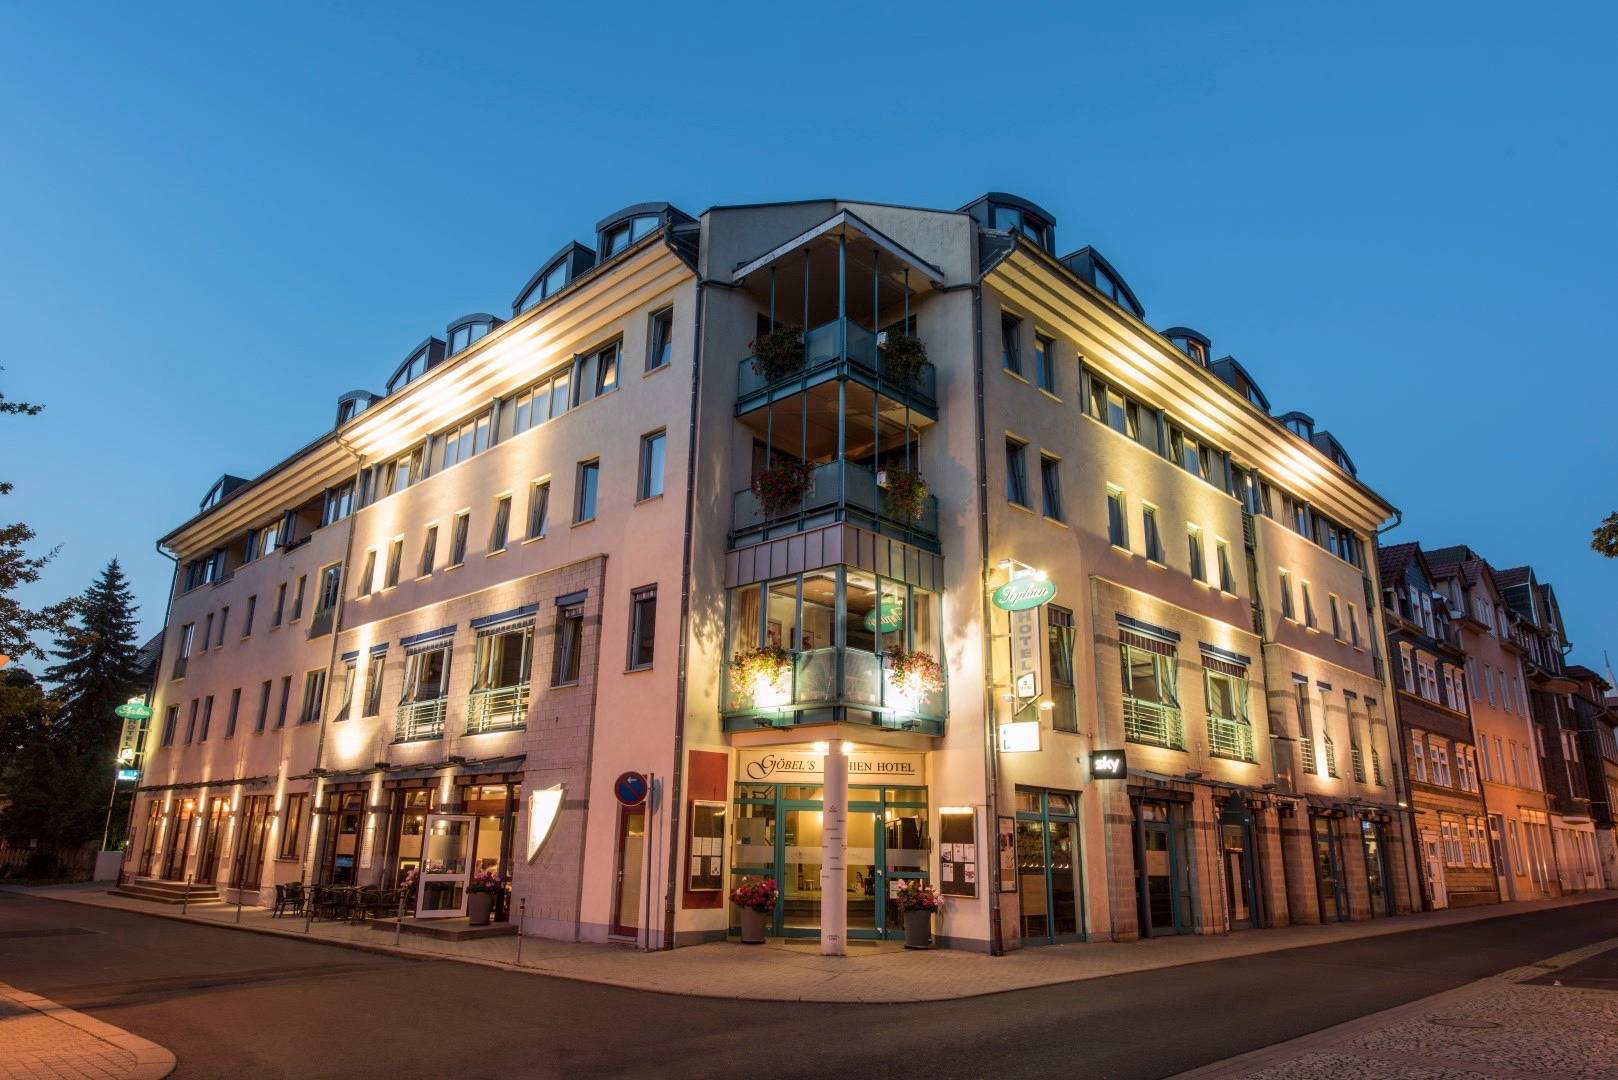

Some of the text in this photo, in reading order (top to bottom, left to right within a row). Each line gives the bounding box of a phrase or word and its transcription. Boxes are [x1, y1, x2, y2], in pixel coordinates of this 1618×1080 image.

[1018, 611, 1033, 671] HOTEL
[877, 762, 915, 773] HOTEL
[1095, 756, 1120, 773] sky
